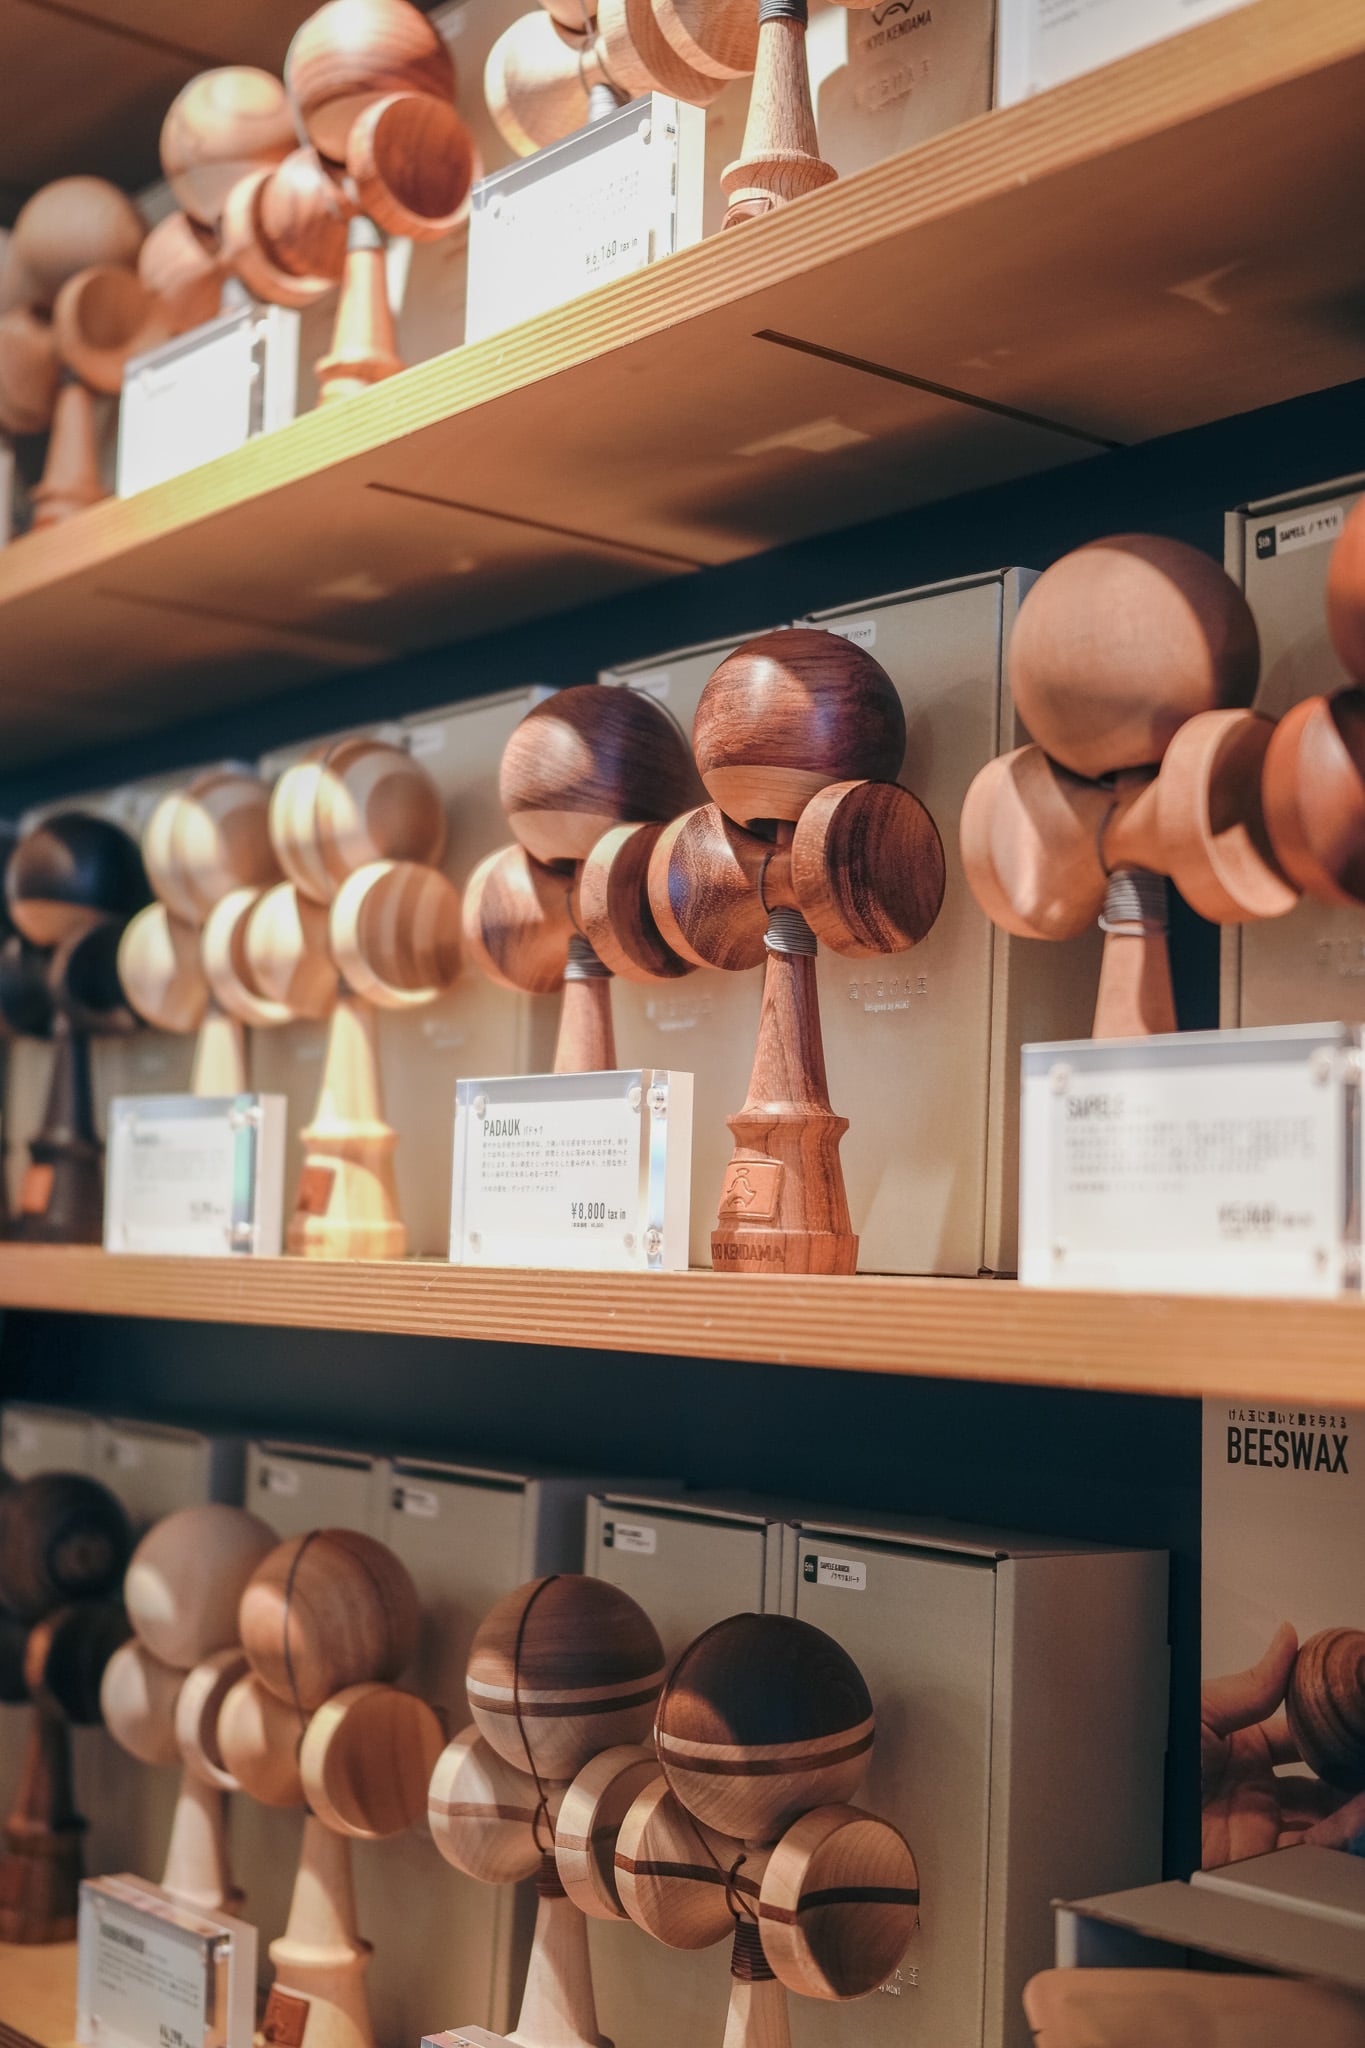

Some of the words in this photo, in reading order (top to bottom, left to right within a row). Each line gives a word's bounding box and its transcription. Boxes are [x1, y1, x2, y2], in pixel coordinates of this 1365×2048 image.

[886, 9, 932, 42] KENDAMA
[483, 1119, 520, 1137] PADAUK
[571, 1202, 605, 1220] ¥8,800
[607, 1208, 618, 1220] tax
[619, 1208, 626, 1220] in
[723, 1243, 785, 1263] KENDAMA
[1227, 1426, 1349, 1474] BEESWAX
